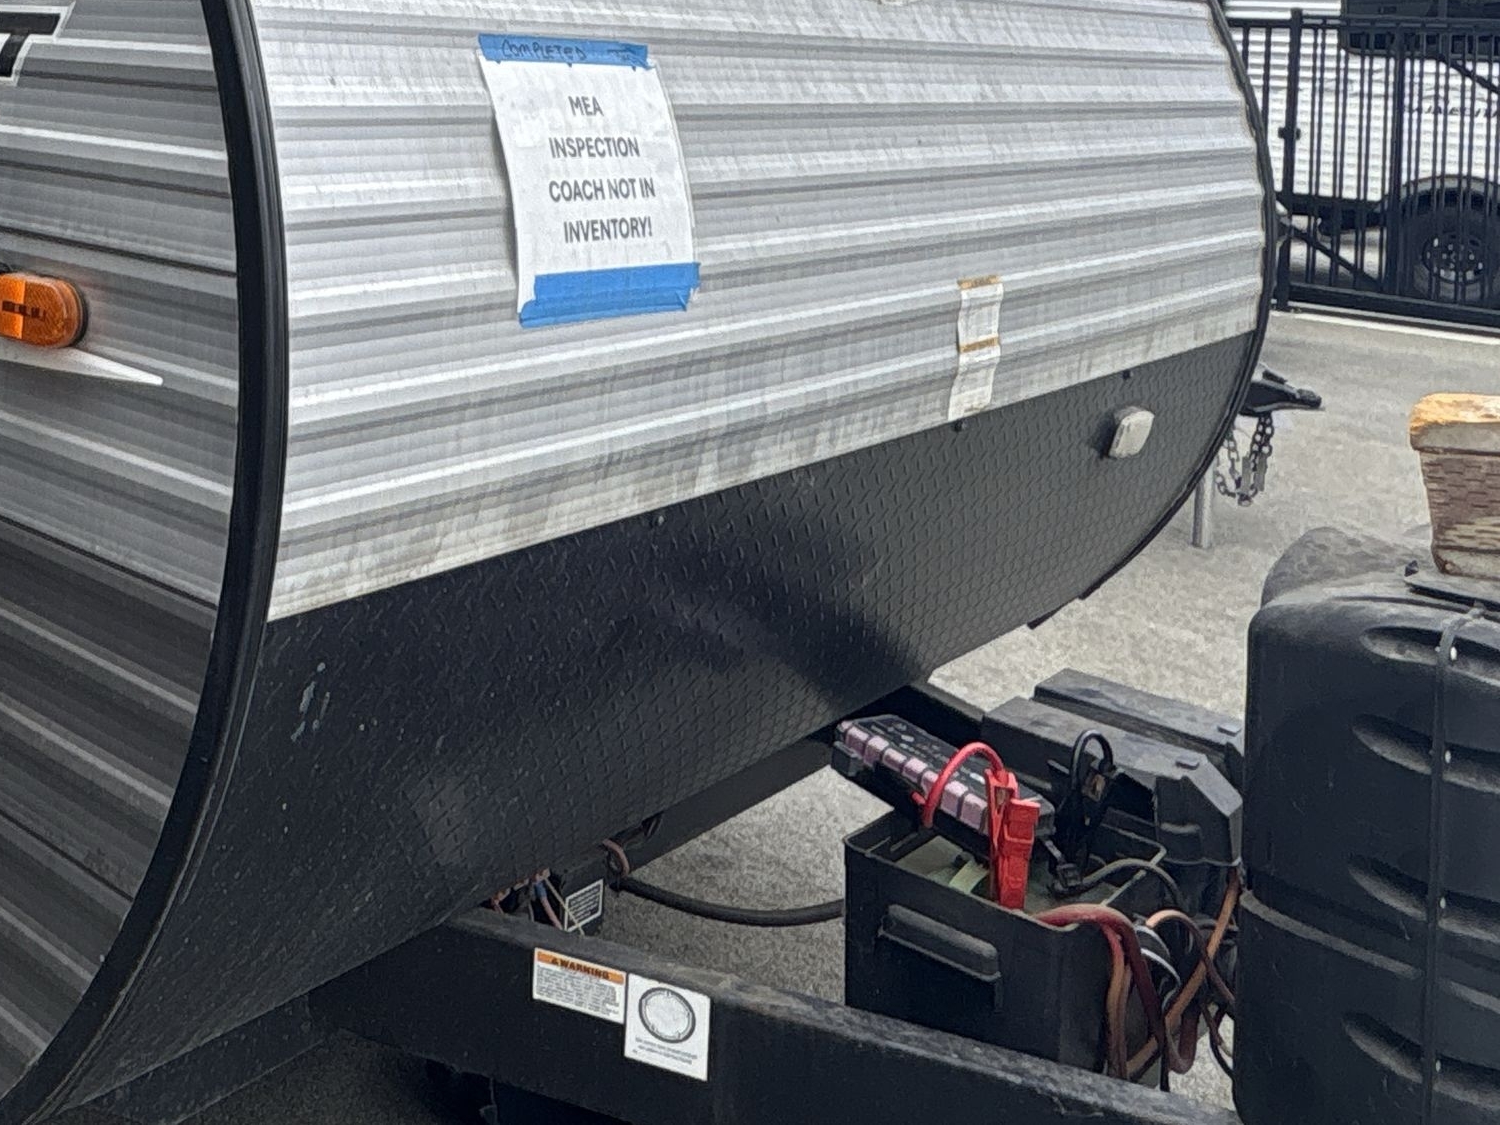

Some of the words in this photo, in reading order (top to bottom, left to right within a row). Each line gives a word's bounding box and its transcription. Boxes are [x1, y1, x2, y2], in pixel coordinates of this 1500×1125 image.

[568, 95, 605, 117] MEA
[549, 136, 640, 158] INSPECTION
[549, 178, 606, 203] COACH
[607, 177, 637, 200] NOT
[639, 177, 656, 198] IN
[563, 215, 653, 244] INVENTORY!
[559, 959, 611, 981] WARNING
